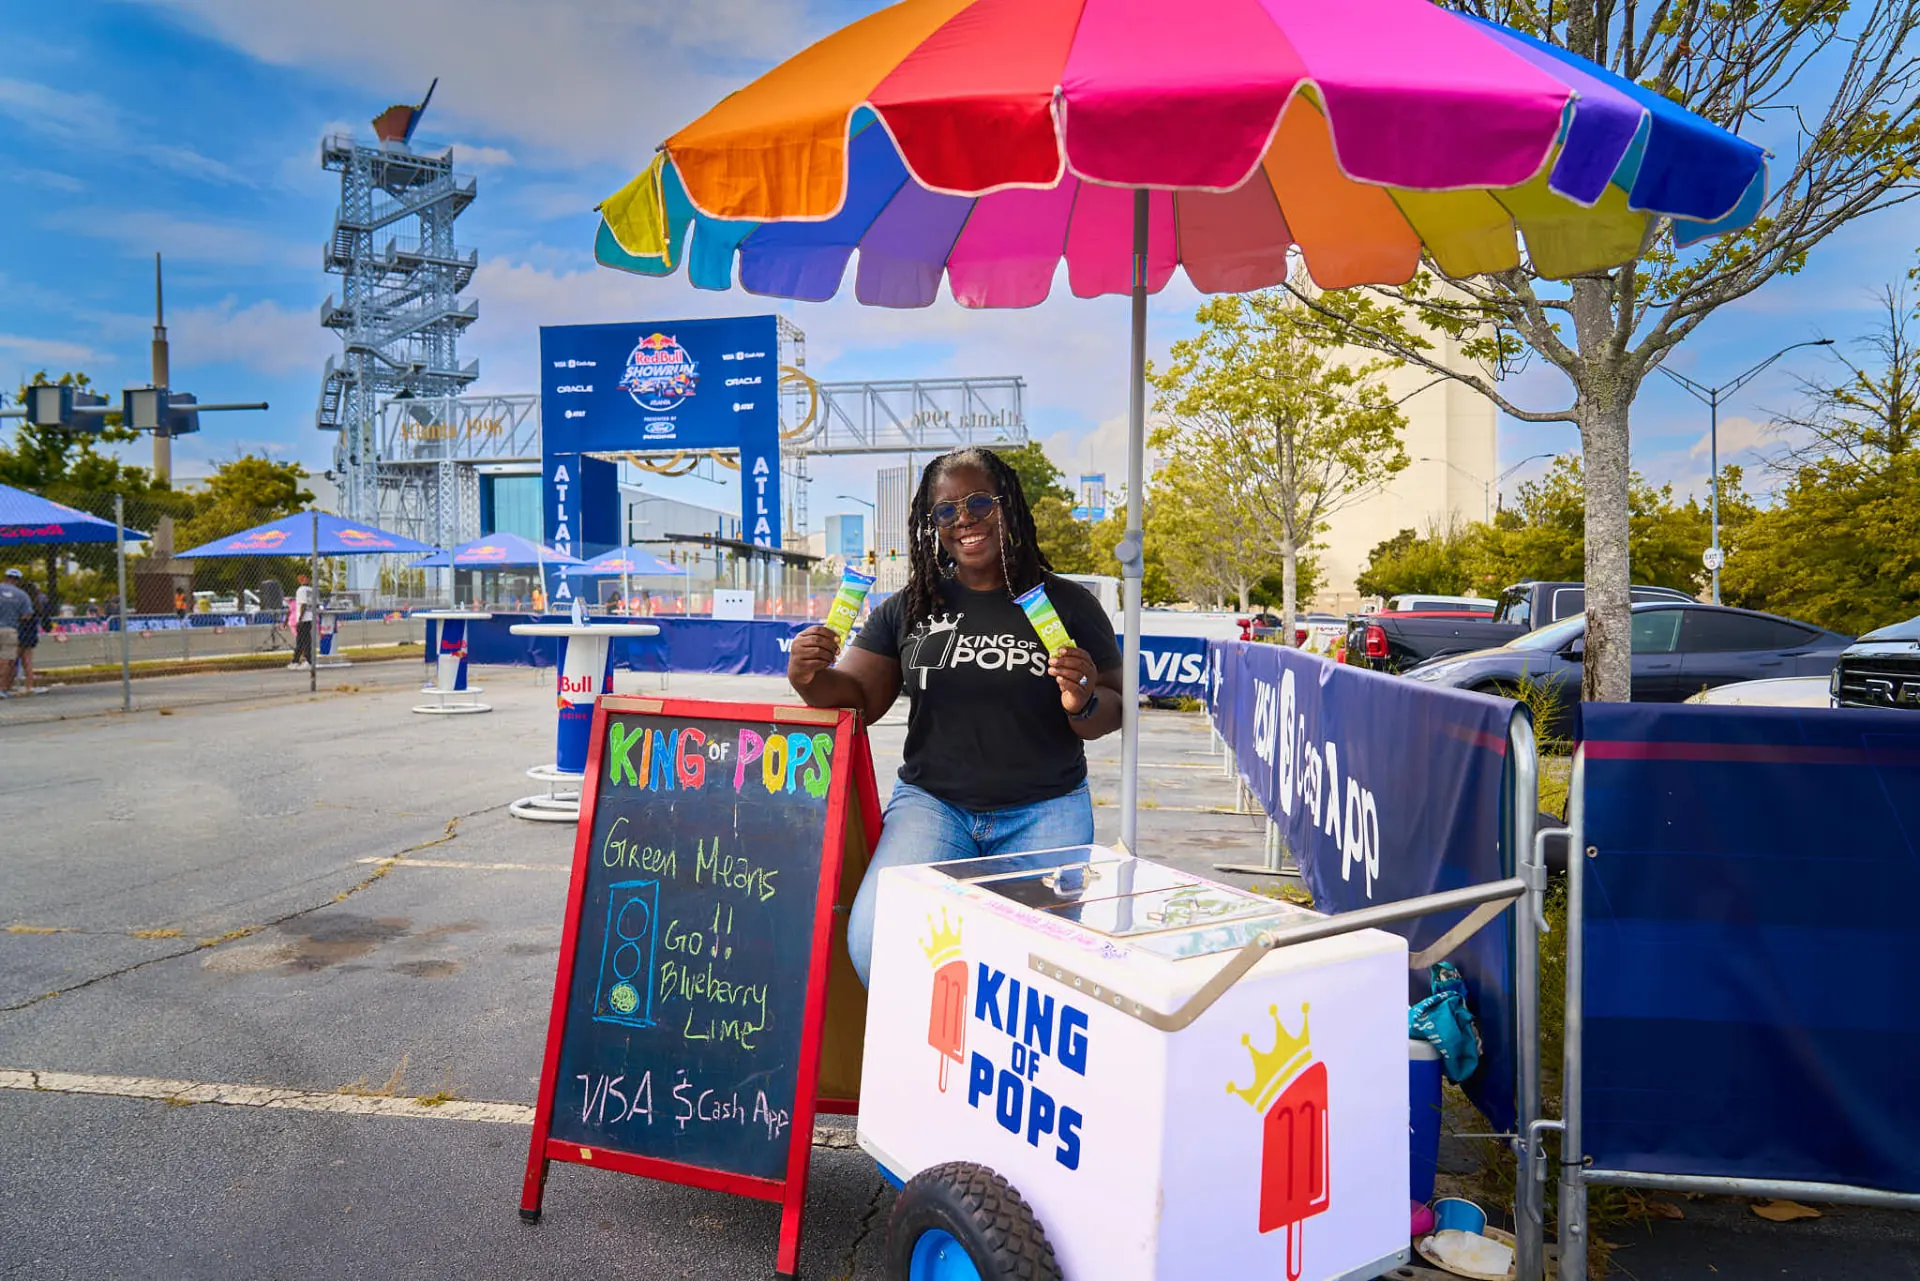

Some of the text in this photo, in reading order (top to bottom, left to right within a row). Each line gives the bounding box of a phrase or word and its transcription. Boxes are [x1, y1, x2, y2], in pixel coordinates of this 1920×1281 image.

[625, 364, 695, 380] SHOWRUN
[635, 349, 683, 364] Red Bull
[725, 376, 762, 387] ORACLE
[557, 384, 594, 394] ORACLE
[753, 457, 771, 547] ATLAN
[951, 646, 1048, 677] POPS
[957, 634, 1038, 651] KING OF
[561, 676, 592, 693] Bull
[609, 721, 834, 799] KING OF POPS
[1325, 741, 1380, 900] App
[695, 835, 779, 901] Means
[659, 960, 768, 1032] Blueberry
[974, 961, 1089, 1077] KING
[1010, 1041, 1041, 1081] OF
[576, 1069, 653, 1126] VISA
[753, 1089, 789, 1141] App
[968, 1050, 1083, 1172] POPS
